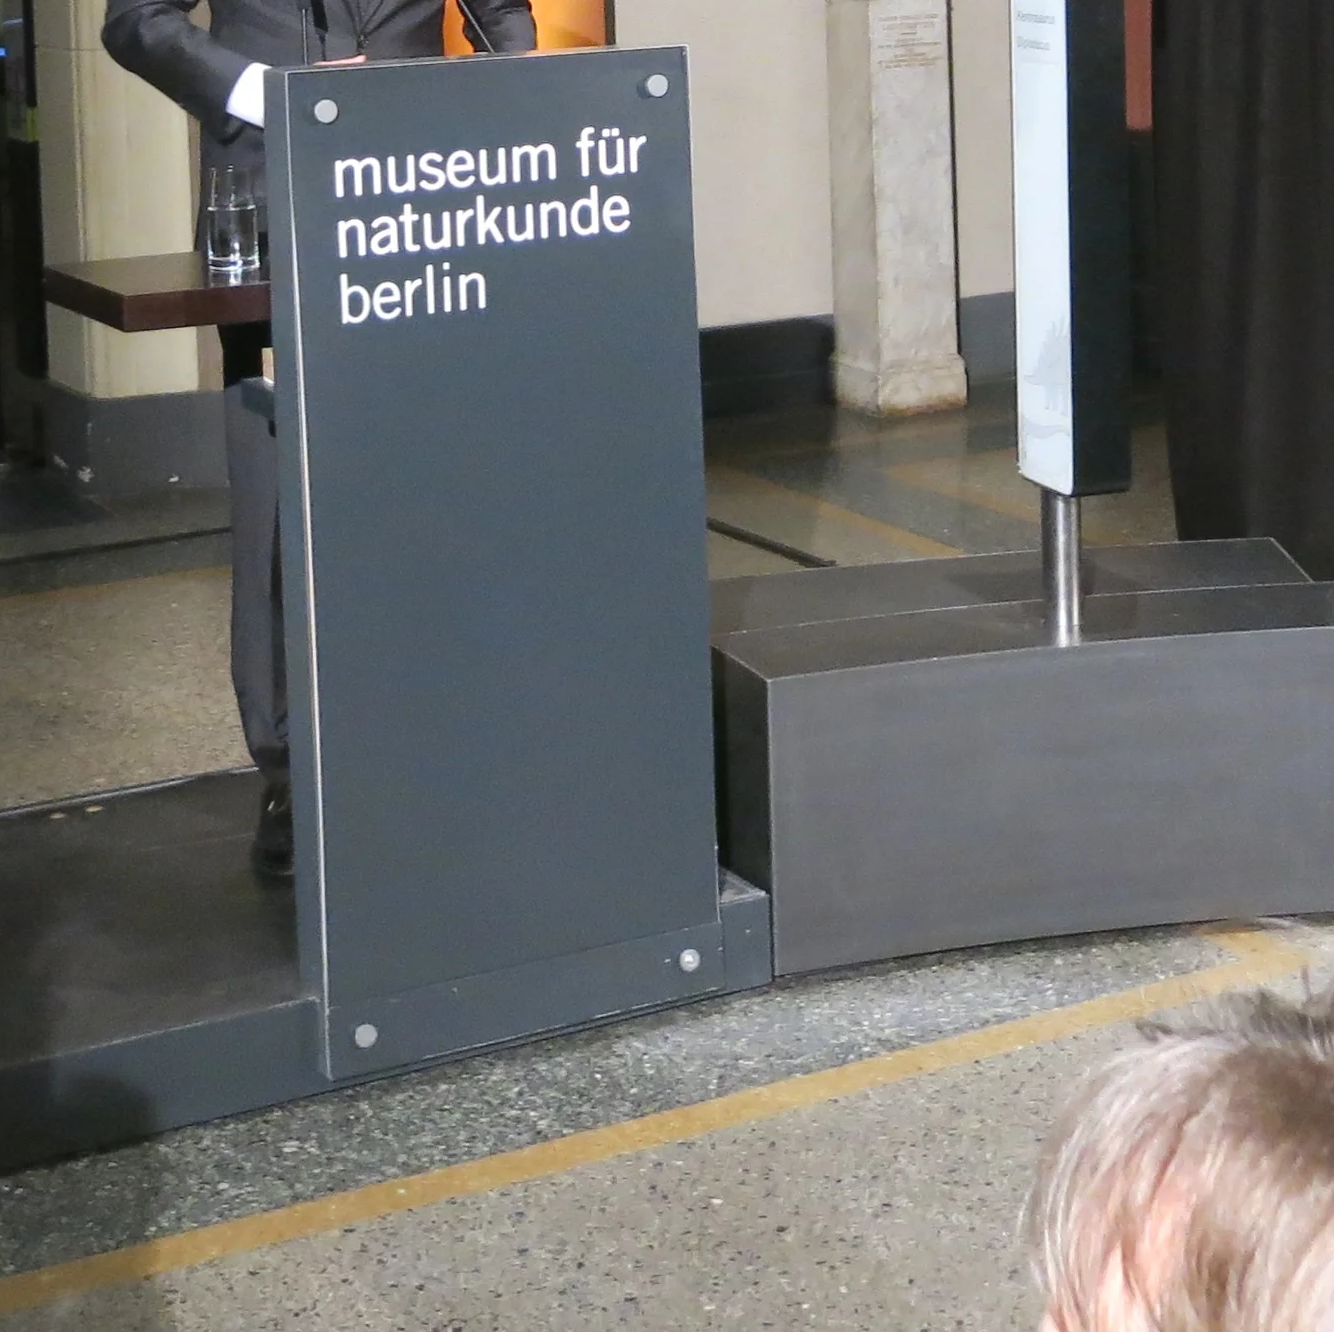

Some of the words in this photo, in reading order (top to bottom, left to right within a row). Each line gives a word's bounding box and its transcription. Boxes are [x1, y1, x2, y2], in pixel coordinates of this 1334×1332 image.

[334, 142, 558, 199] museum
[575, 126, 647, 178] für
[337, 185, 631, 258] naturkunde
[339, 262, 487, 326] berlin
